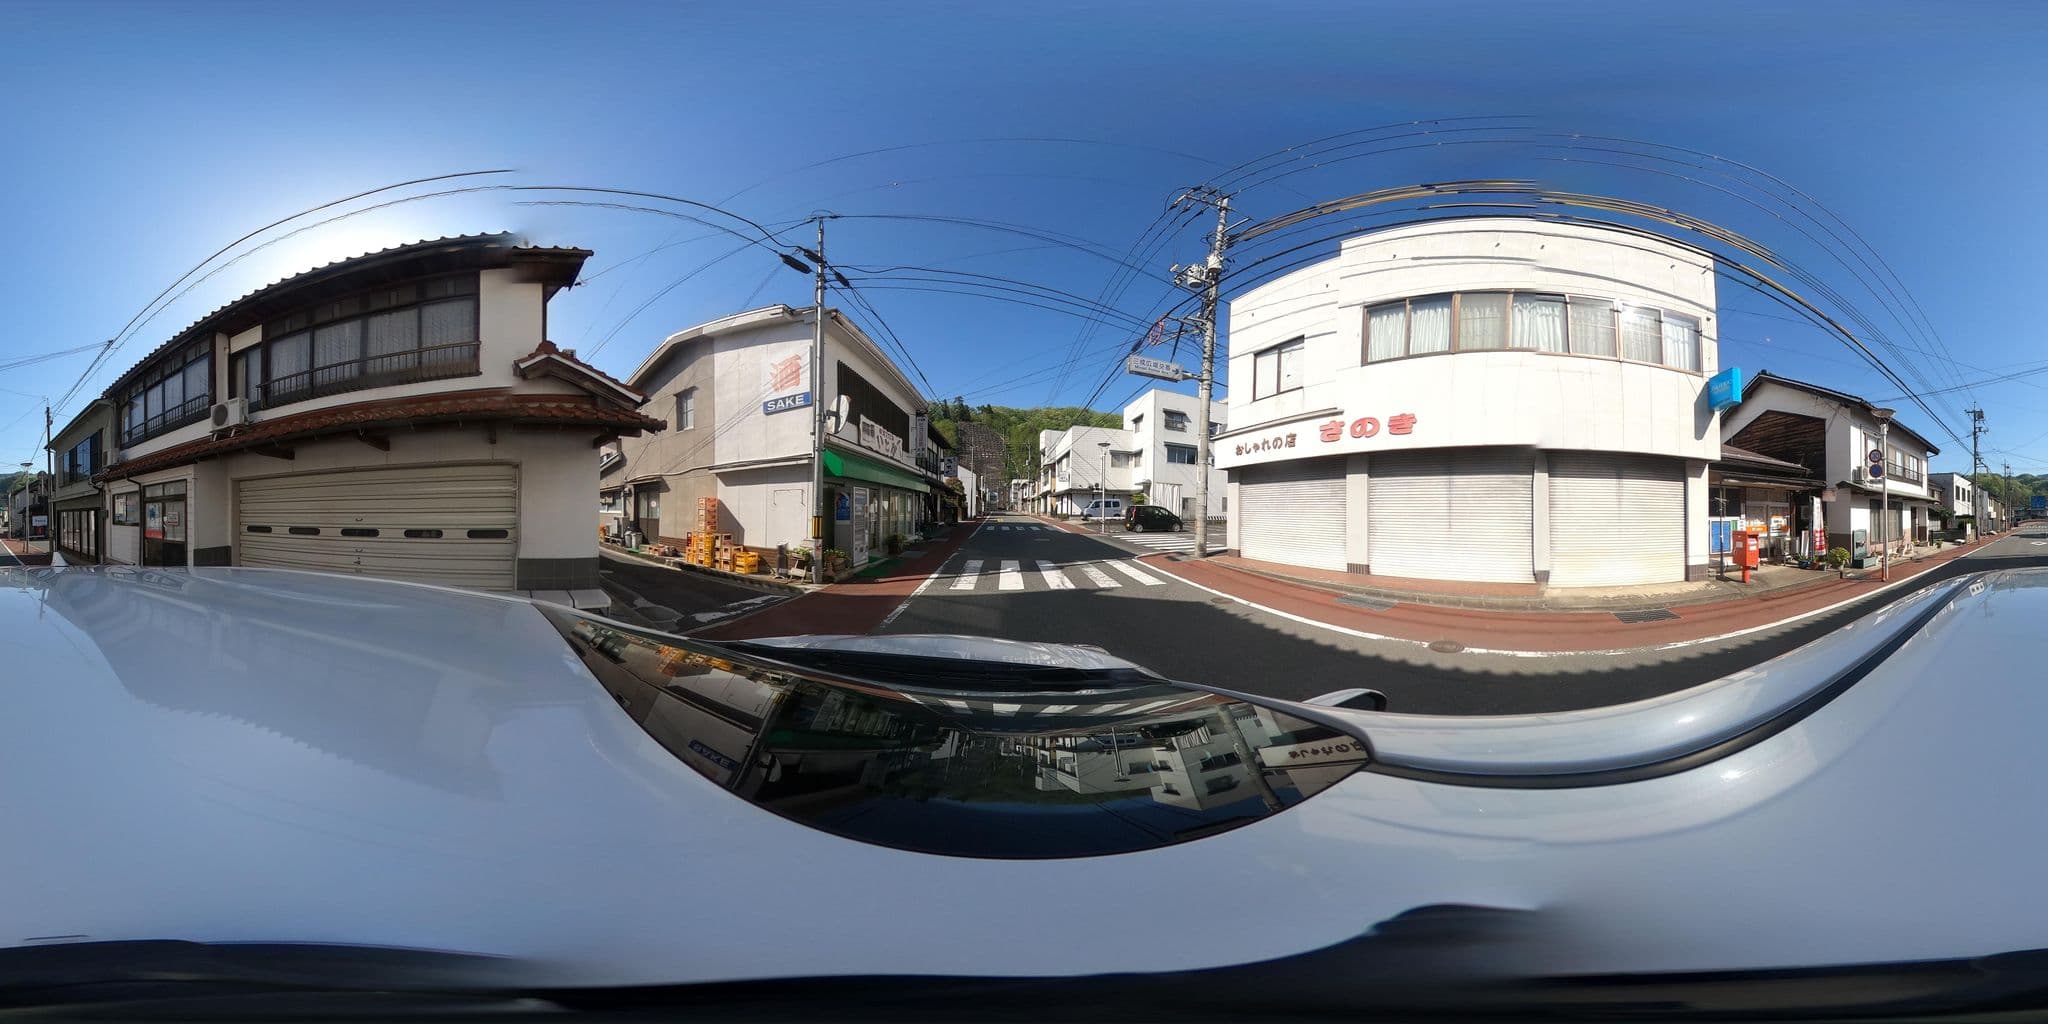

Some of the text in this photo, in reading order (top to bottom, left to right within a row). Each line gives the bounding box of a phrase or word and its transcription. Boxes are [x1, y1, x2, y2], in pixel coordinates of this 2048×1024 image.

[767, 395, 804, 410] SAKE
[1235, 413, 1417, 456] おしゃれの店 さのき
